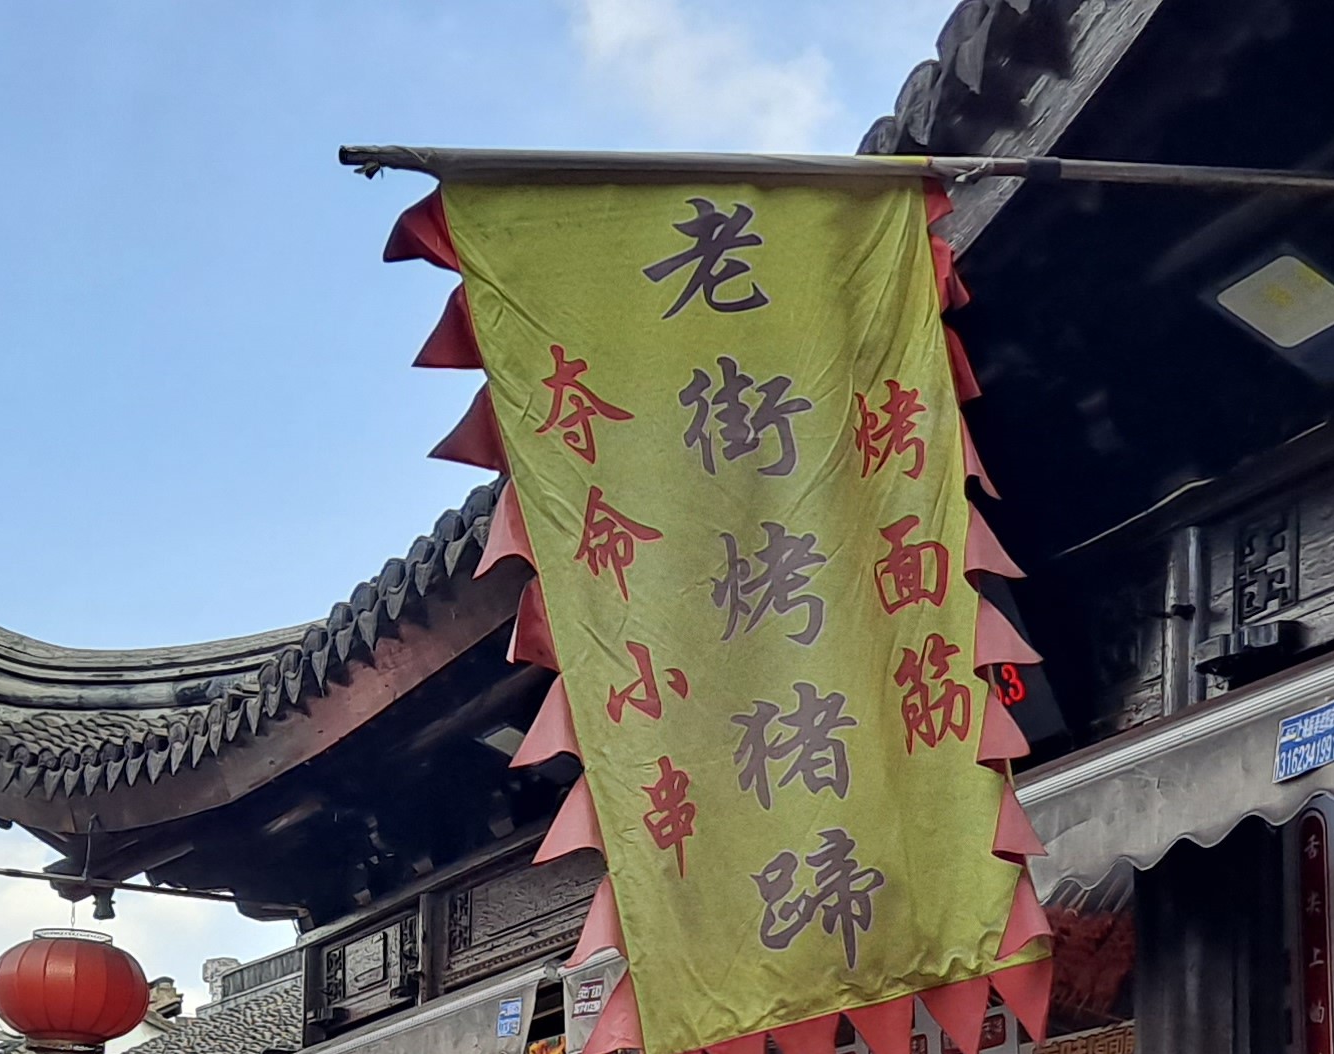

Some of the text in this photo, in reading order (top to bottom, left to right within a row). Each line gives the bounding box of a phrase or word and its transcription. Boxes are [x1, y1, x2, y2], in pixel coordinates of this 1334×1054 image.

[534, 343, 699, 880] 夺命小串
[642, 197, 885, 971] 老街烤猪蹄
[854, 379, 971, 755] 烤面筋
